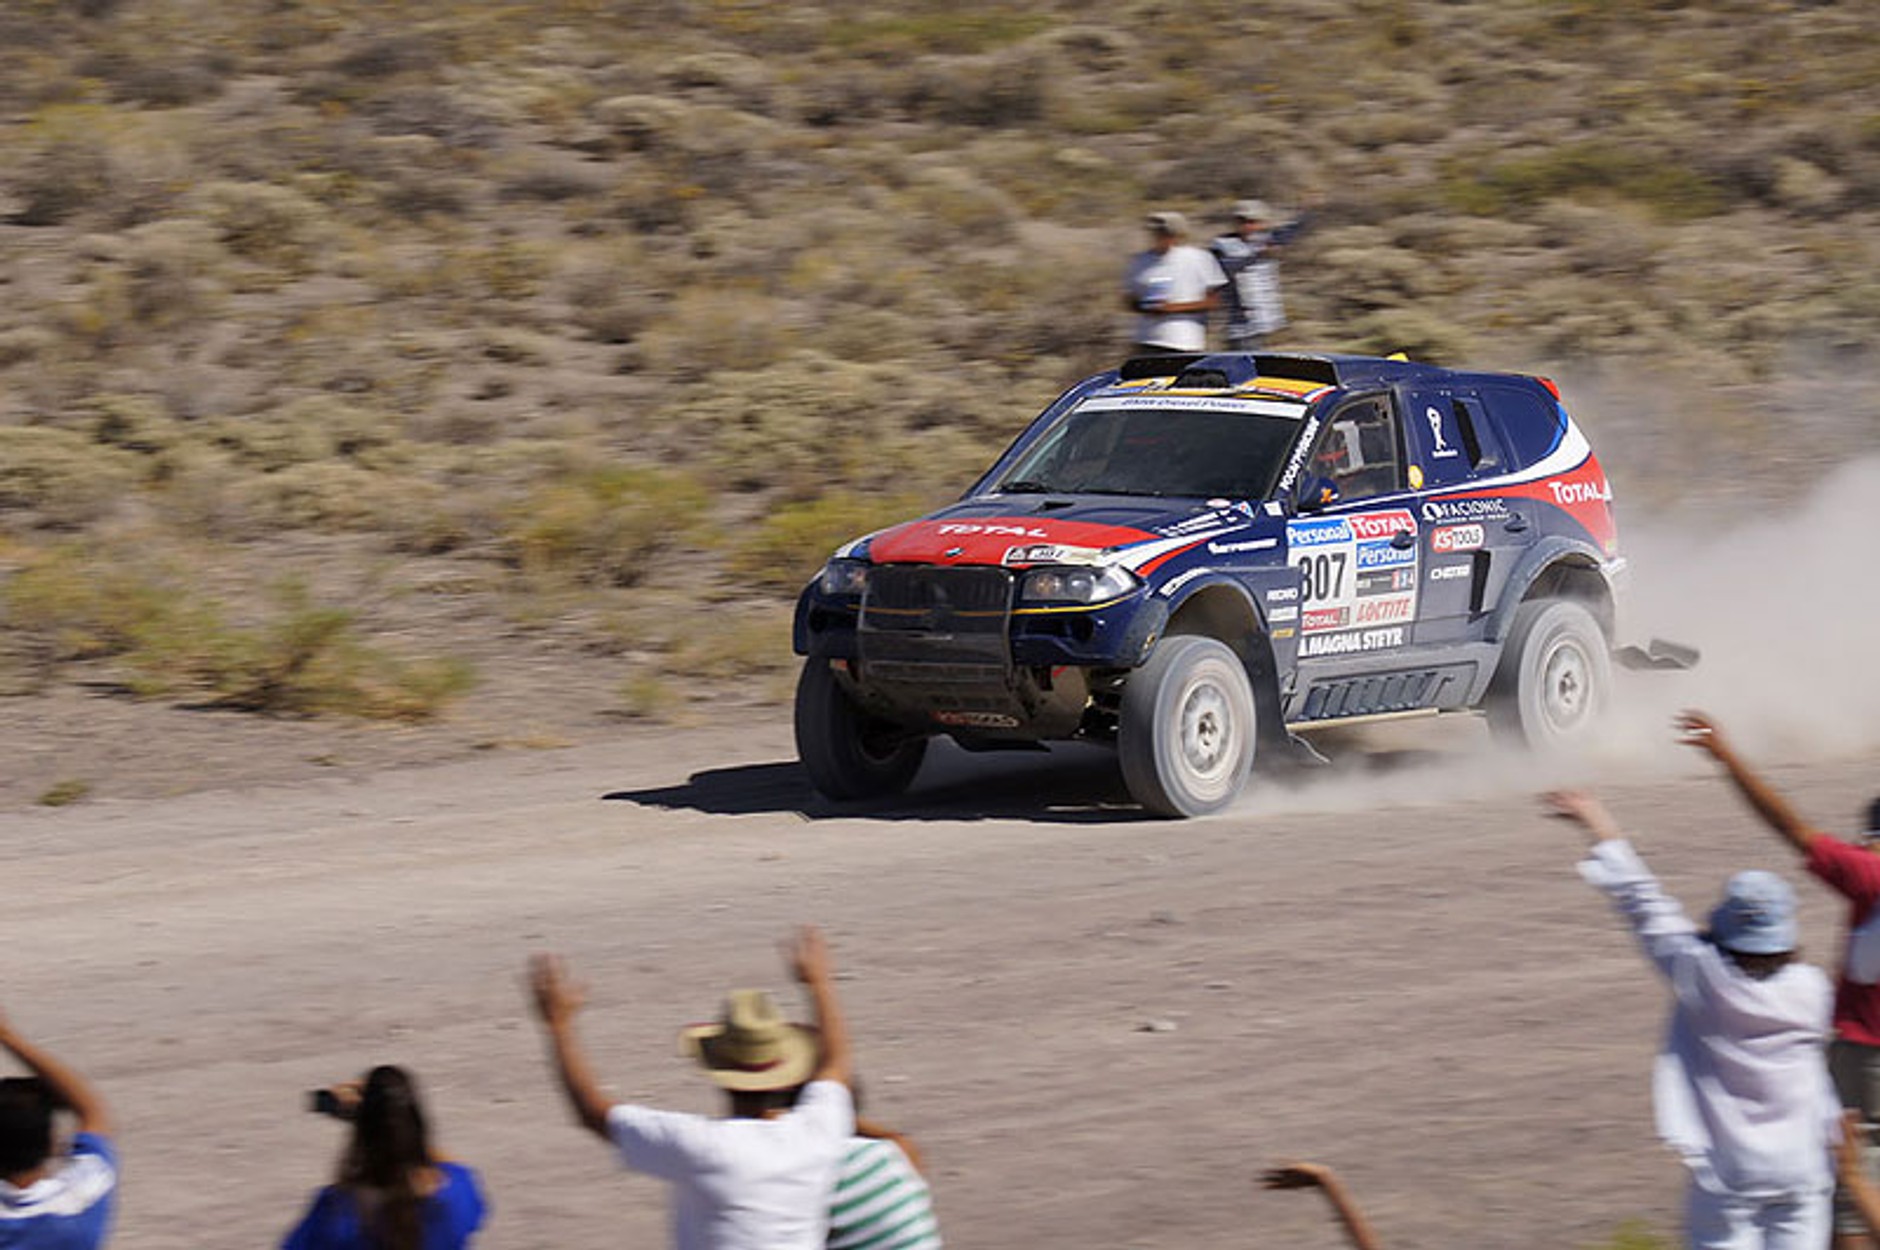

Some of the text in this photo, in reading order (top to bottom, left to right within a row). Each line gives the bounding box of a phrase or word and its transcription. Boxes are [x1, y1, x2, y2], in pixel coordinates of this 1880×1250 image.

[1548, 482, 1601, 504] TOTAL
[937, 523, 1048, 537] TOTAL
[1287, 521, 1351, 544] Personal
[1351, 516, 1415, 536] TOTAL
[1298, 552, 1348, 603] 307
[1302, 613, 1338, 629] TOTAL
[1356, 599, 1411, 622] LOCTITE
[1309, 631, 1362, 656] MAGNA
[1362, 627, 1403, 650] STEYR
